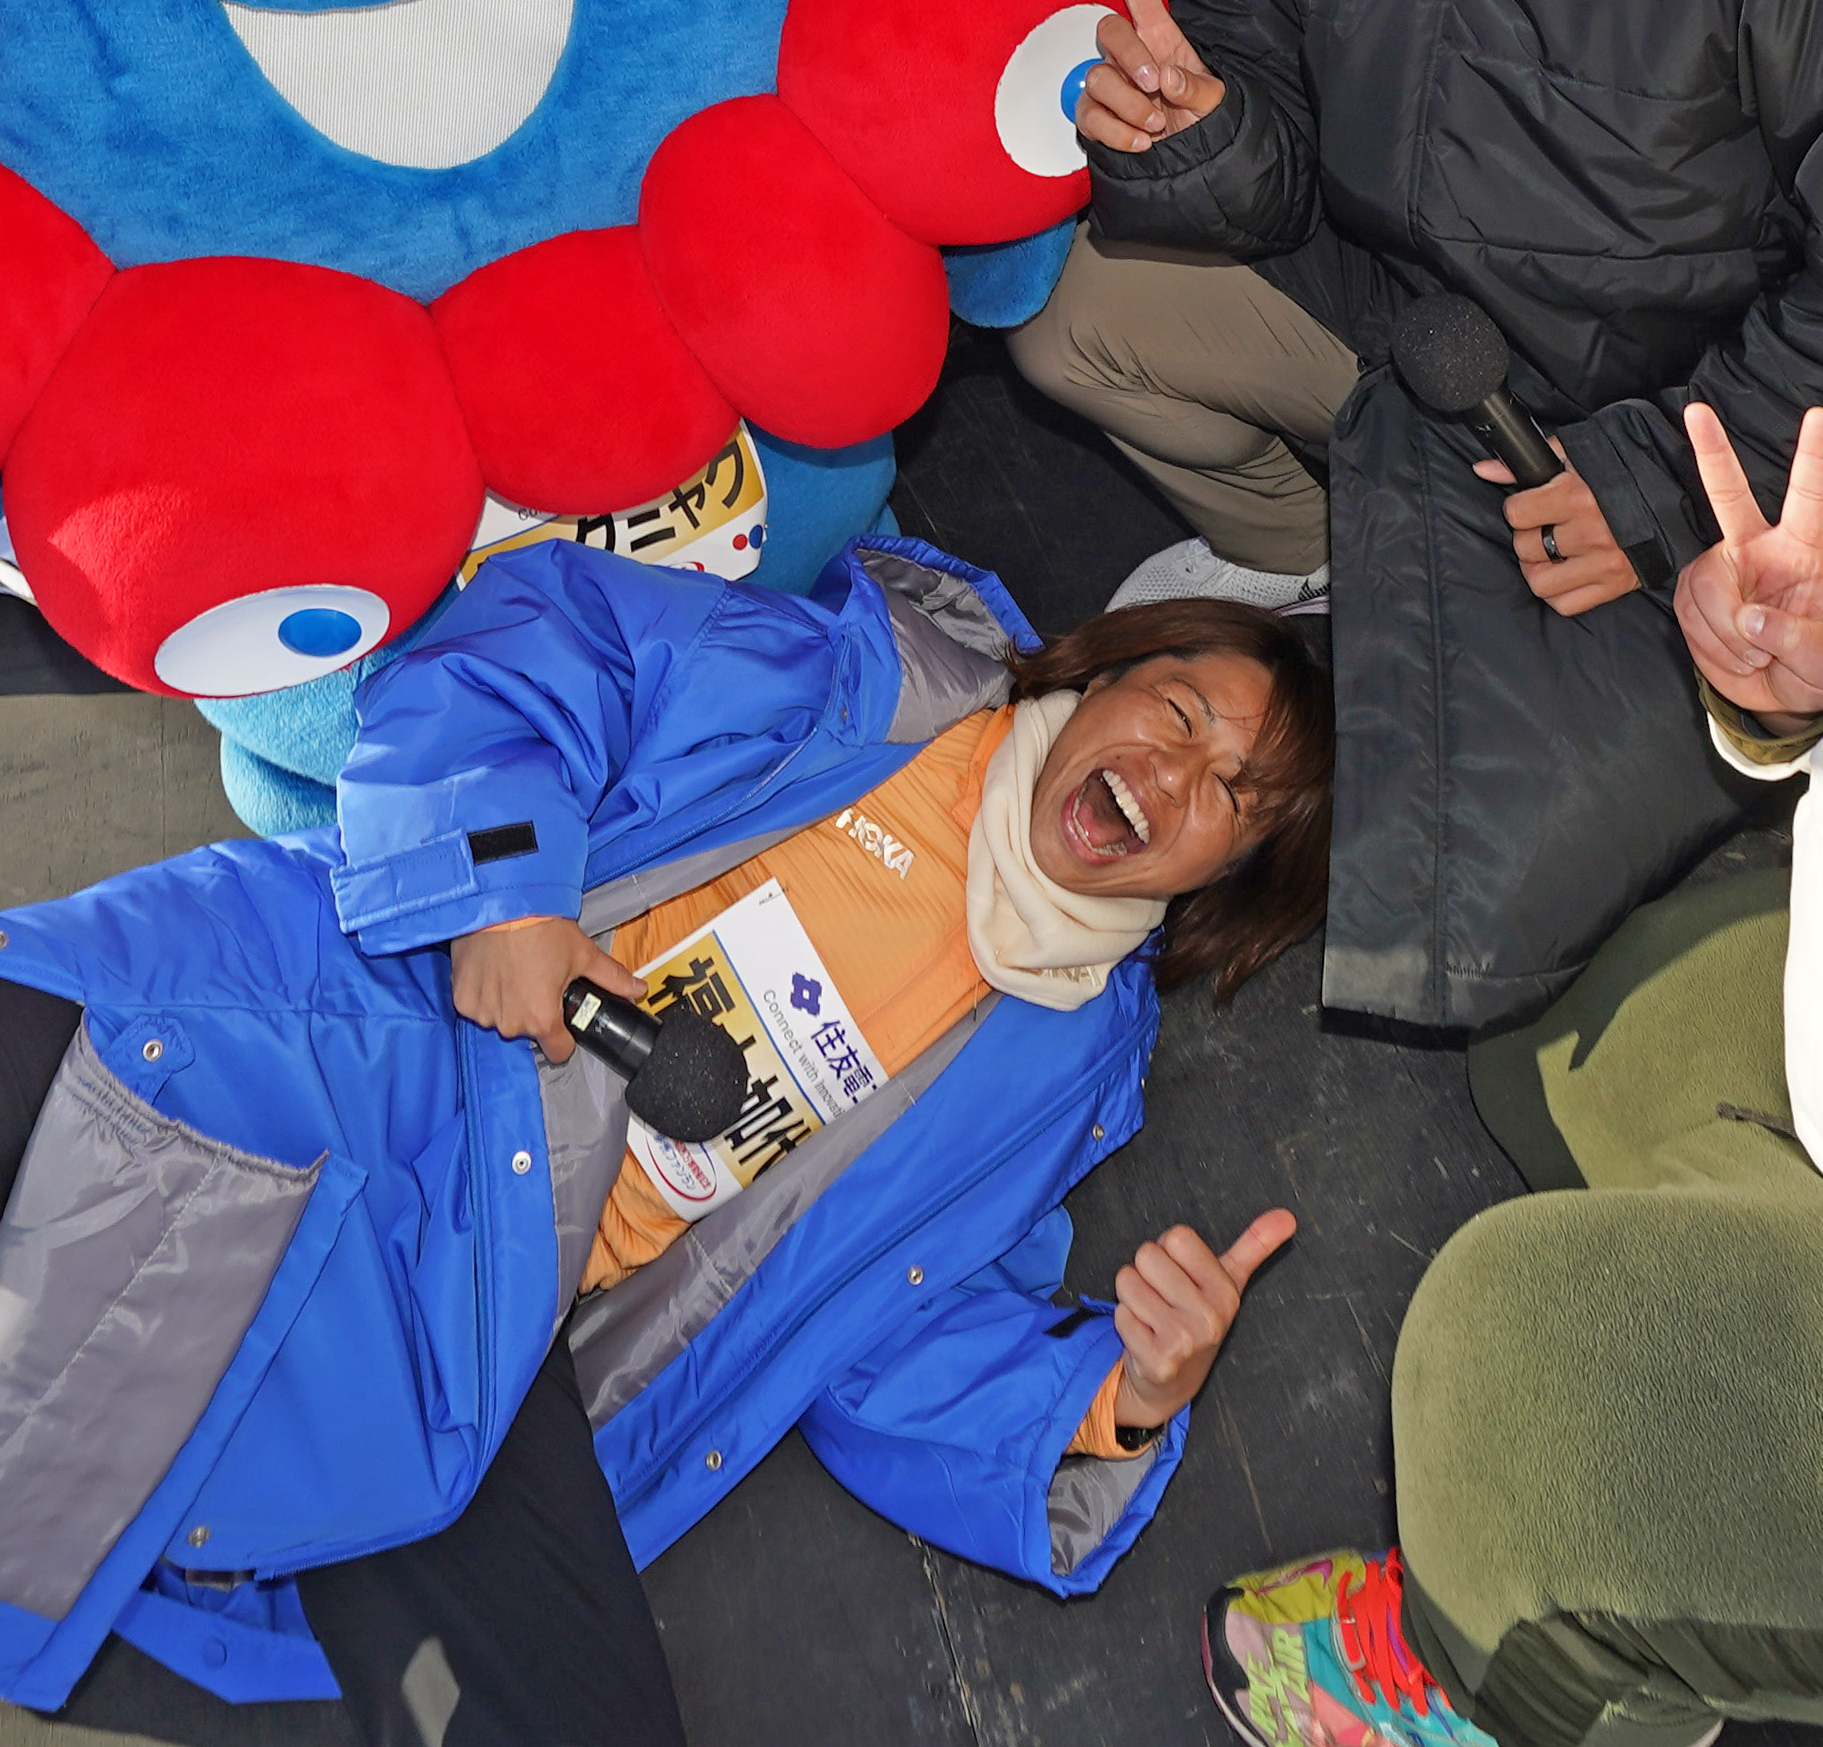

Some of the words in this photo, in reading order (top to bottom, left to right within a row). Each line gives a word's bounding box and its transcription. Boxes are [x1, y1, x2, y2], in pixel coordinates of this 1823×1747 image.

[762, 988, 804, 1056] Connect
[798, 1051, 819, 1084] with
[810, 1019, 879, 1104] 住友電
